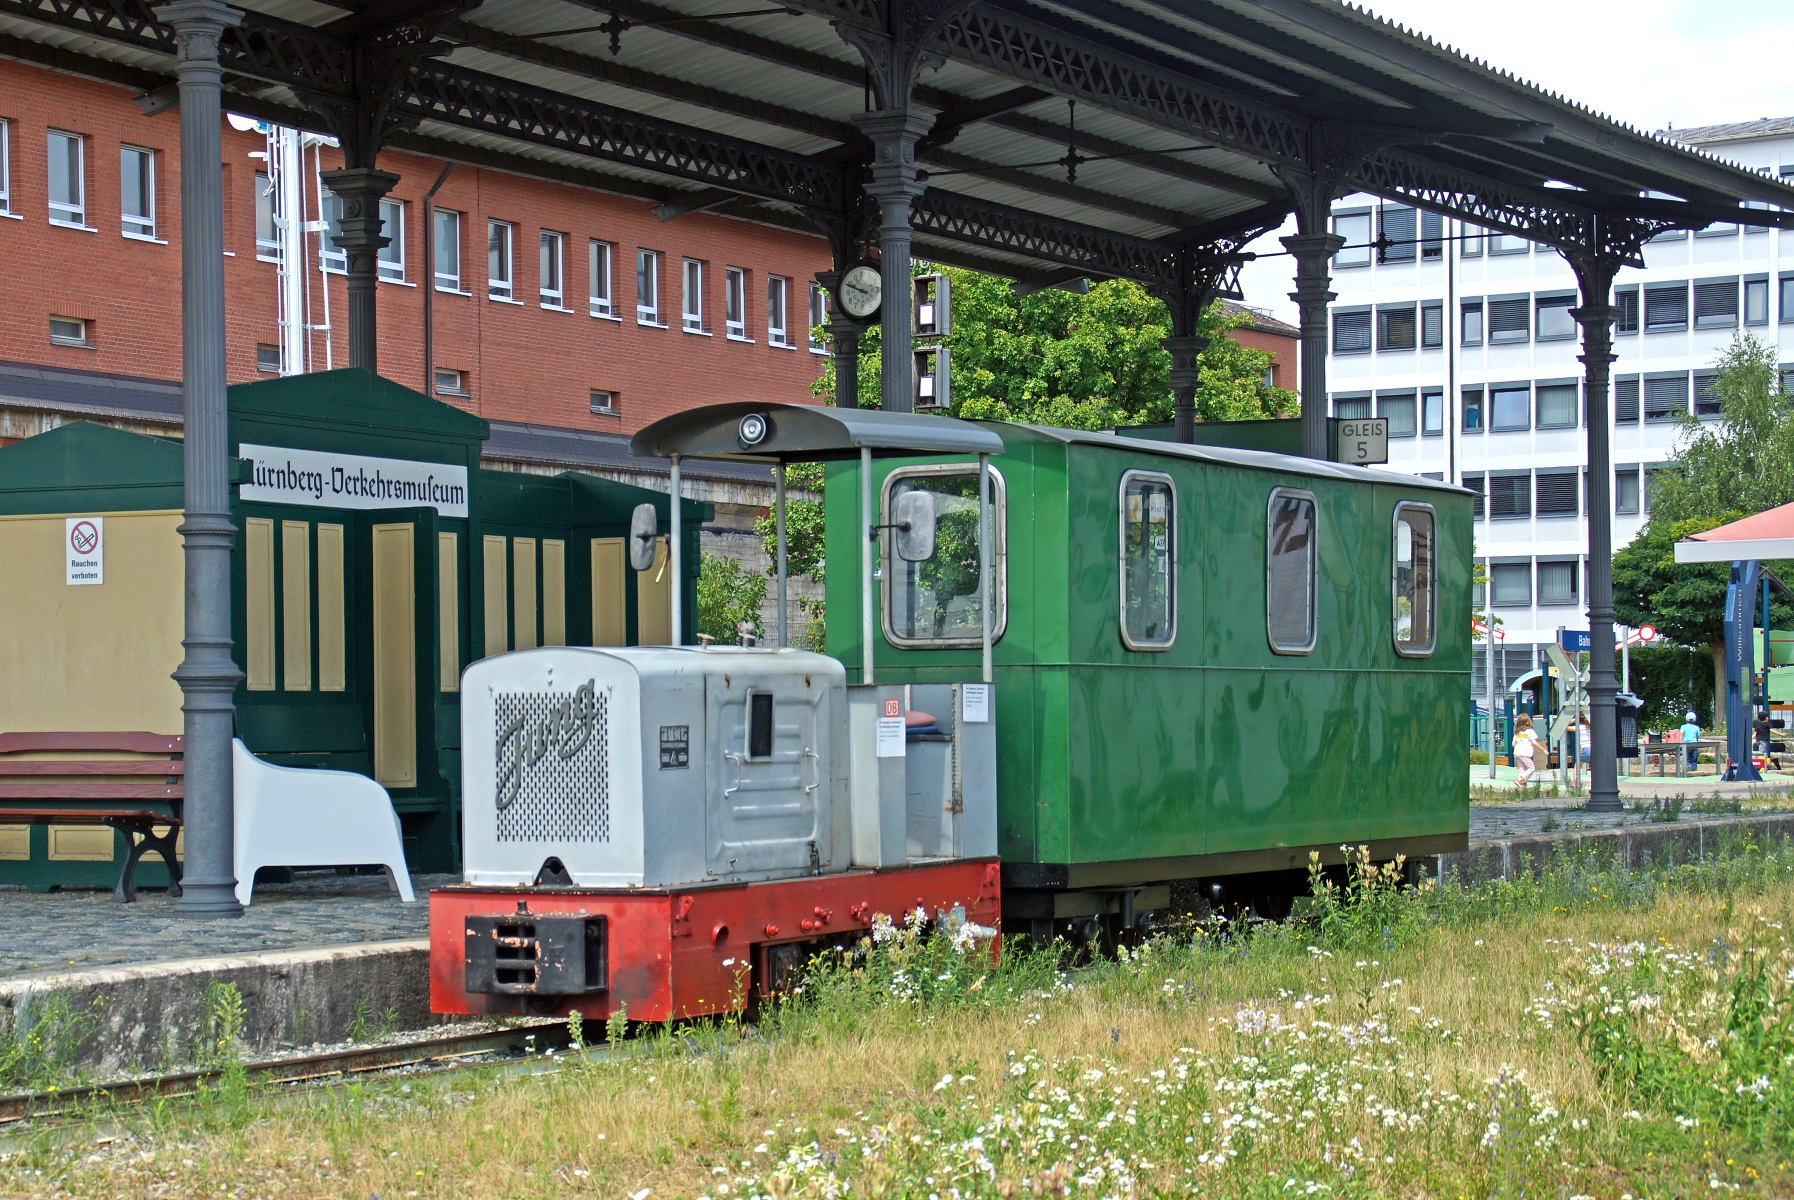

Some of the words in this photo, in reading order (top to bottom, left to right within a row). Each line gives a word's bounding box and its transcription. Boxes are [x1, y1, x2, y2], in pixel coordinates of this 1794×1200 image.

[1342, 423, 1383, 437] GLEIS
[1357, 441, 1368, 459] 5
[1578, 634, 1591, 647] Bah
[886, 701, 899, 714] DB
[495, 678, 600, 809] Jung
